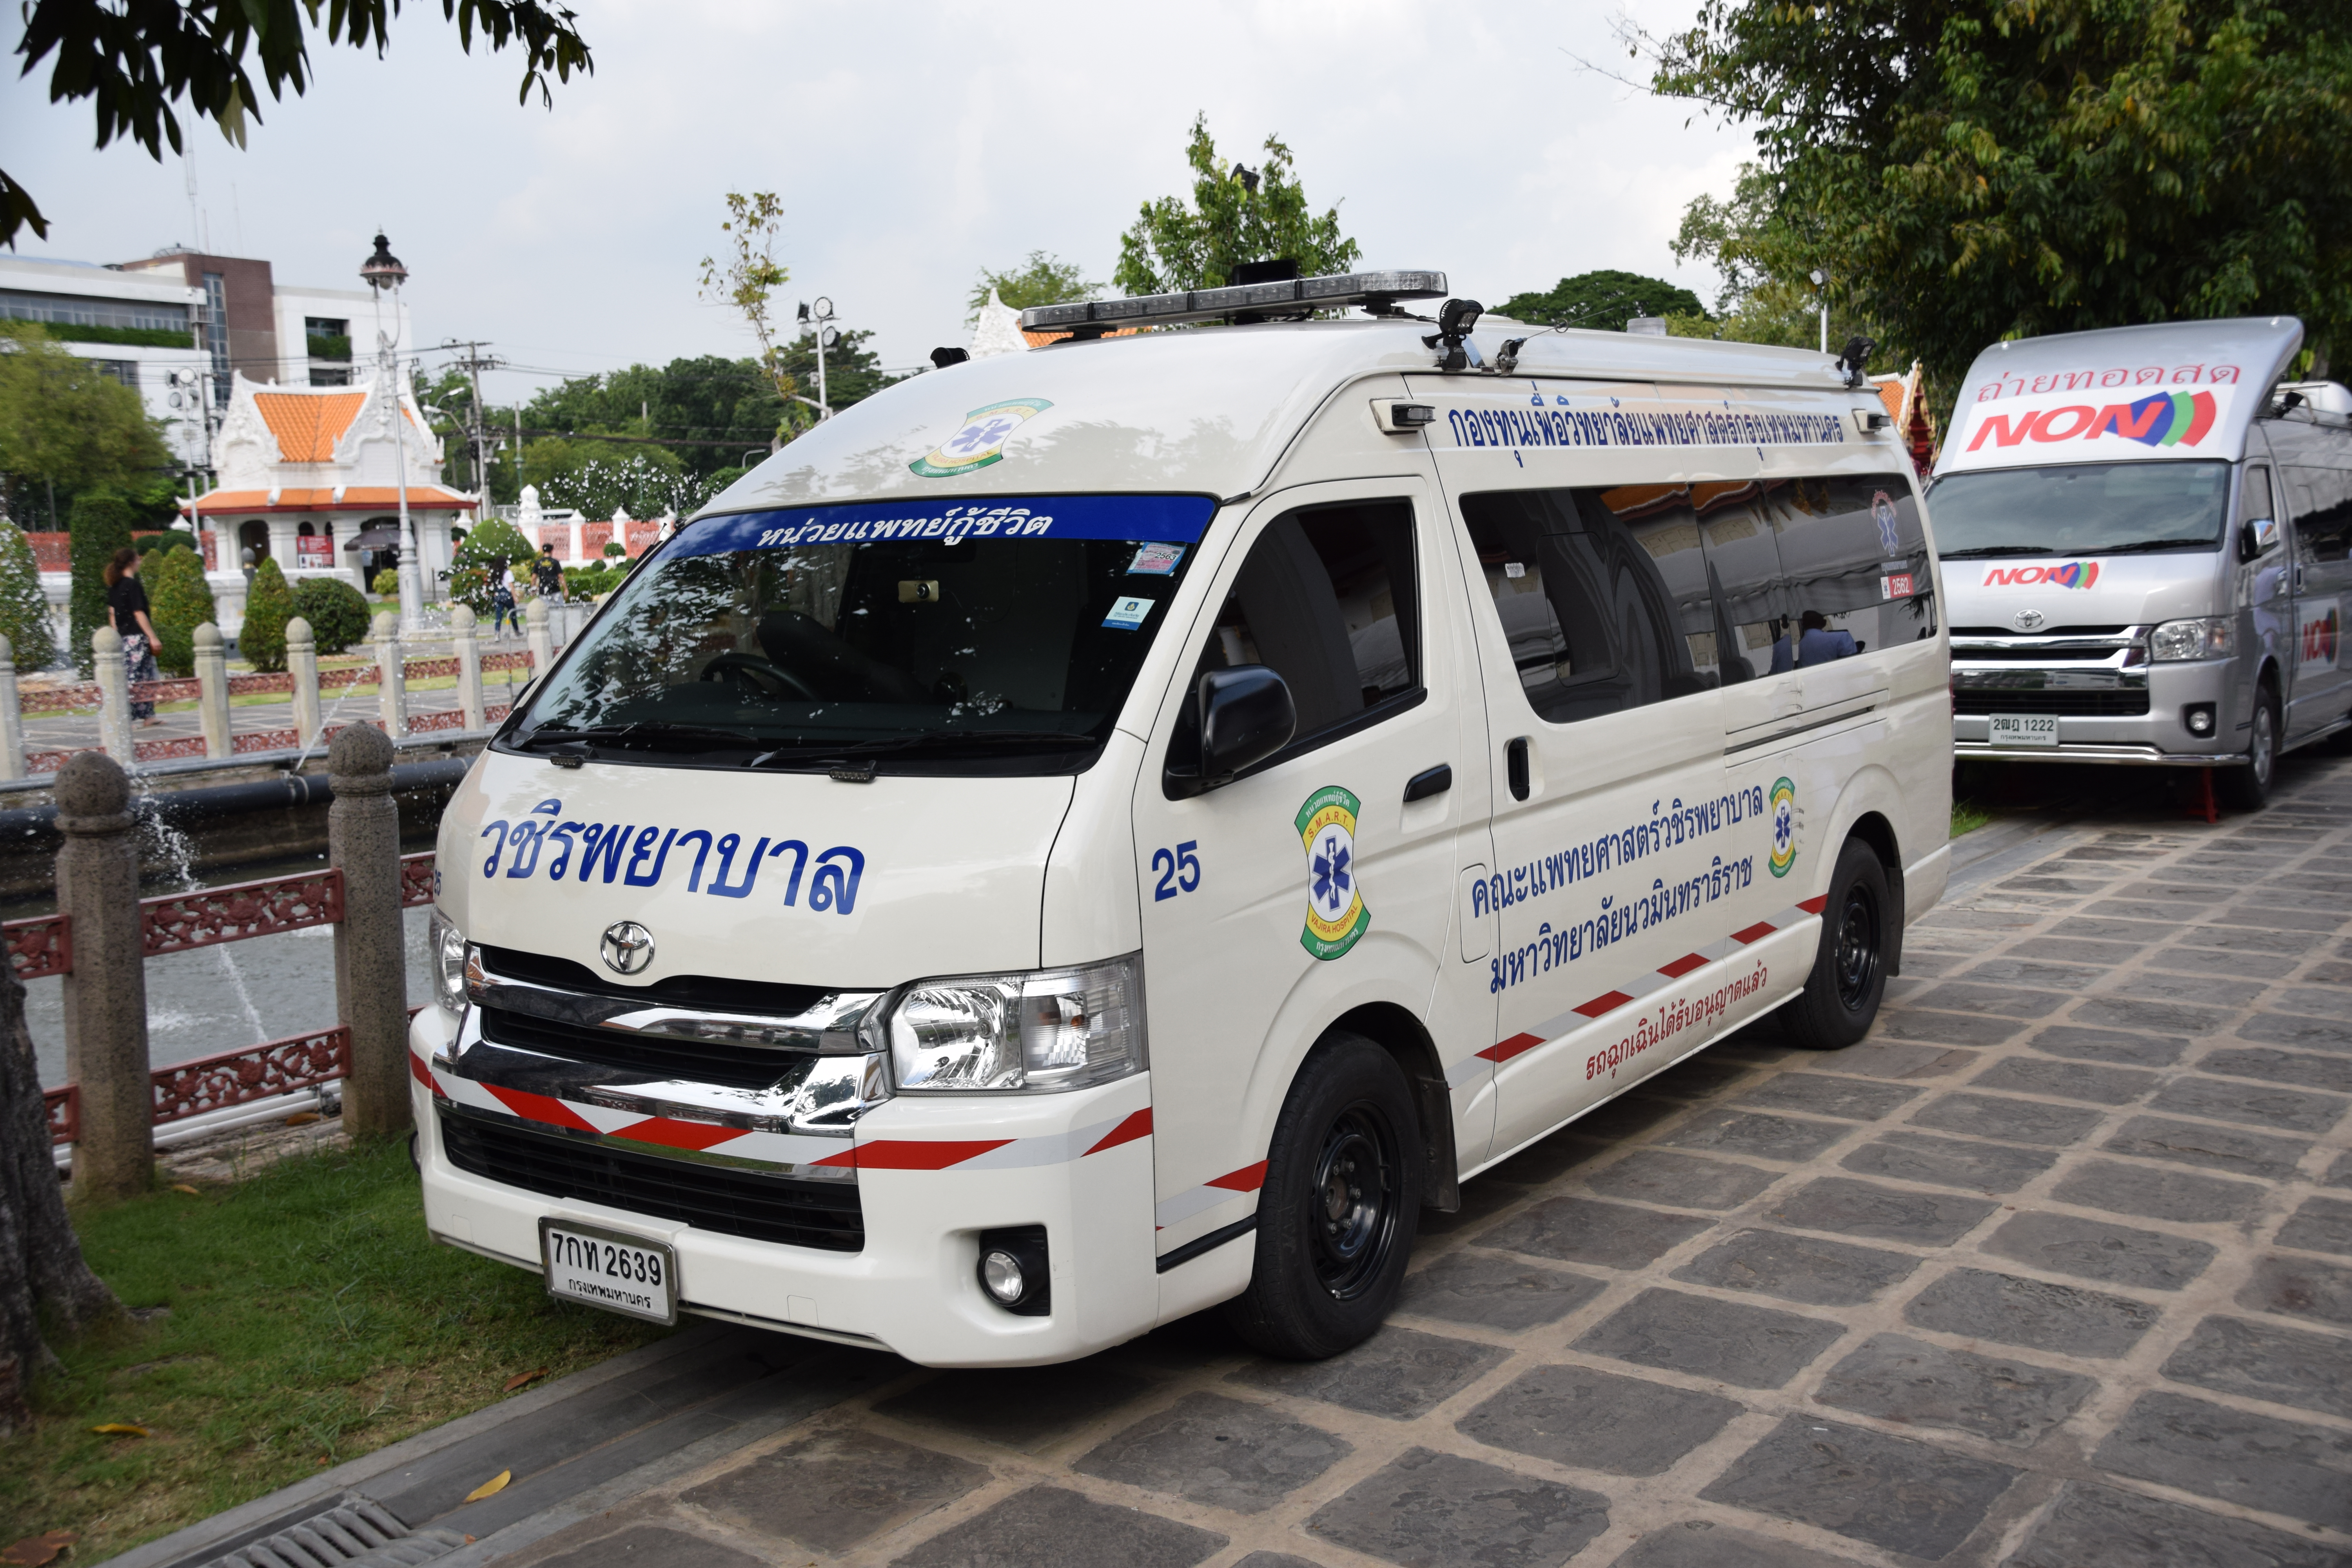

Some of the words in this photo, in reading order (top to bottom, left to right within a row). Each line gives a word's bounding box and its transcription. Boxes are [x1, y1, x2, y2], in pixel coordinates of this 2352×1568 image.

[1977, 363, 2240, 403] ถ่ายทอดสด
[1448, 381, 1843, 468] กองทุนเพื่อวิทยาลัยแพทยศาสตร์กรุงเทพมหานคร
[1965, 402, 2167, 453] NON
[932, 453, 948, 464] VAJIRA
[949, 451, 992, 464] HOSPITAL
[757, 507, 1053, 546] หน่วยแพทย์กู้ชีวิต
[1155, 552, 1176, 561] 2563
[1983, 566, 2077, 586] NON
[1892, 577, 1909, 595] 2562
[2025, 719, 2054, 731] 1222
[481, 799, 865, 915] วชิรพยาบาล
[1152, 839, 1201, 903] 25
[1472, 786, 1763, 919] คณะแพทยศาสตร์วชิรพยาบาล
[1311, 914, 1331, 934] VAJIRA
[1332, 905, 1357, 934] HOSPITAL
[1490, 855, 1753, 994] มหาวิทยาลัยนวมินทราธิราช
[1586, 959, 1767, 1081] รถฉุกเฉินได้รับอนุญาตแล้ว
[552, 1232, 599, 1272] 7กท
[604, 1245, 662, 1286] 2639
[568, 1279, 651, 1308] กรุงเทพมหานคร
